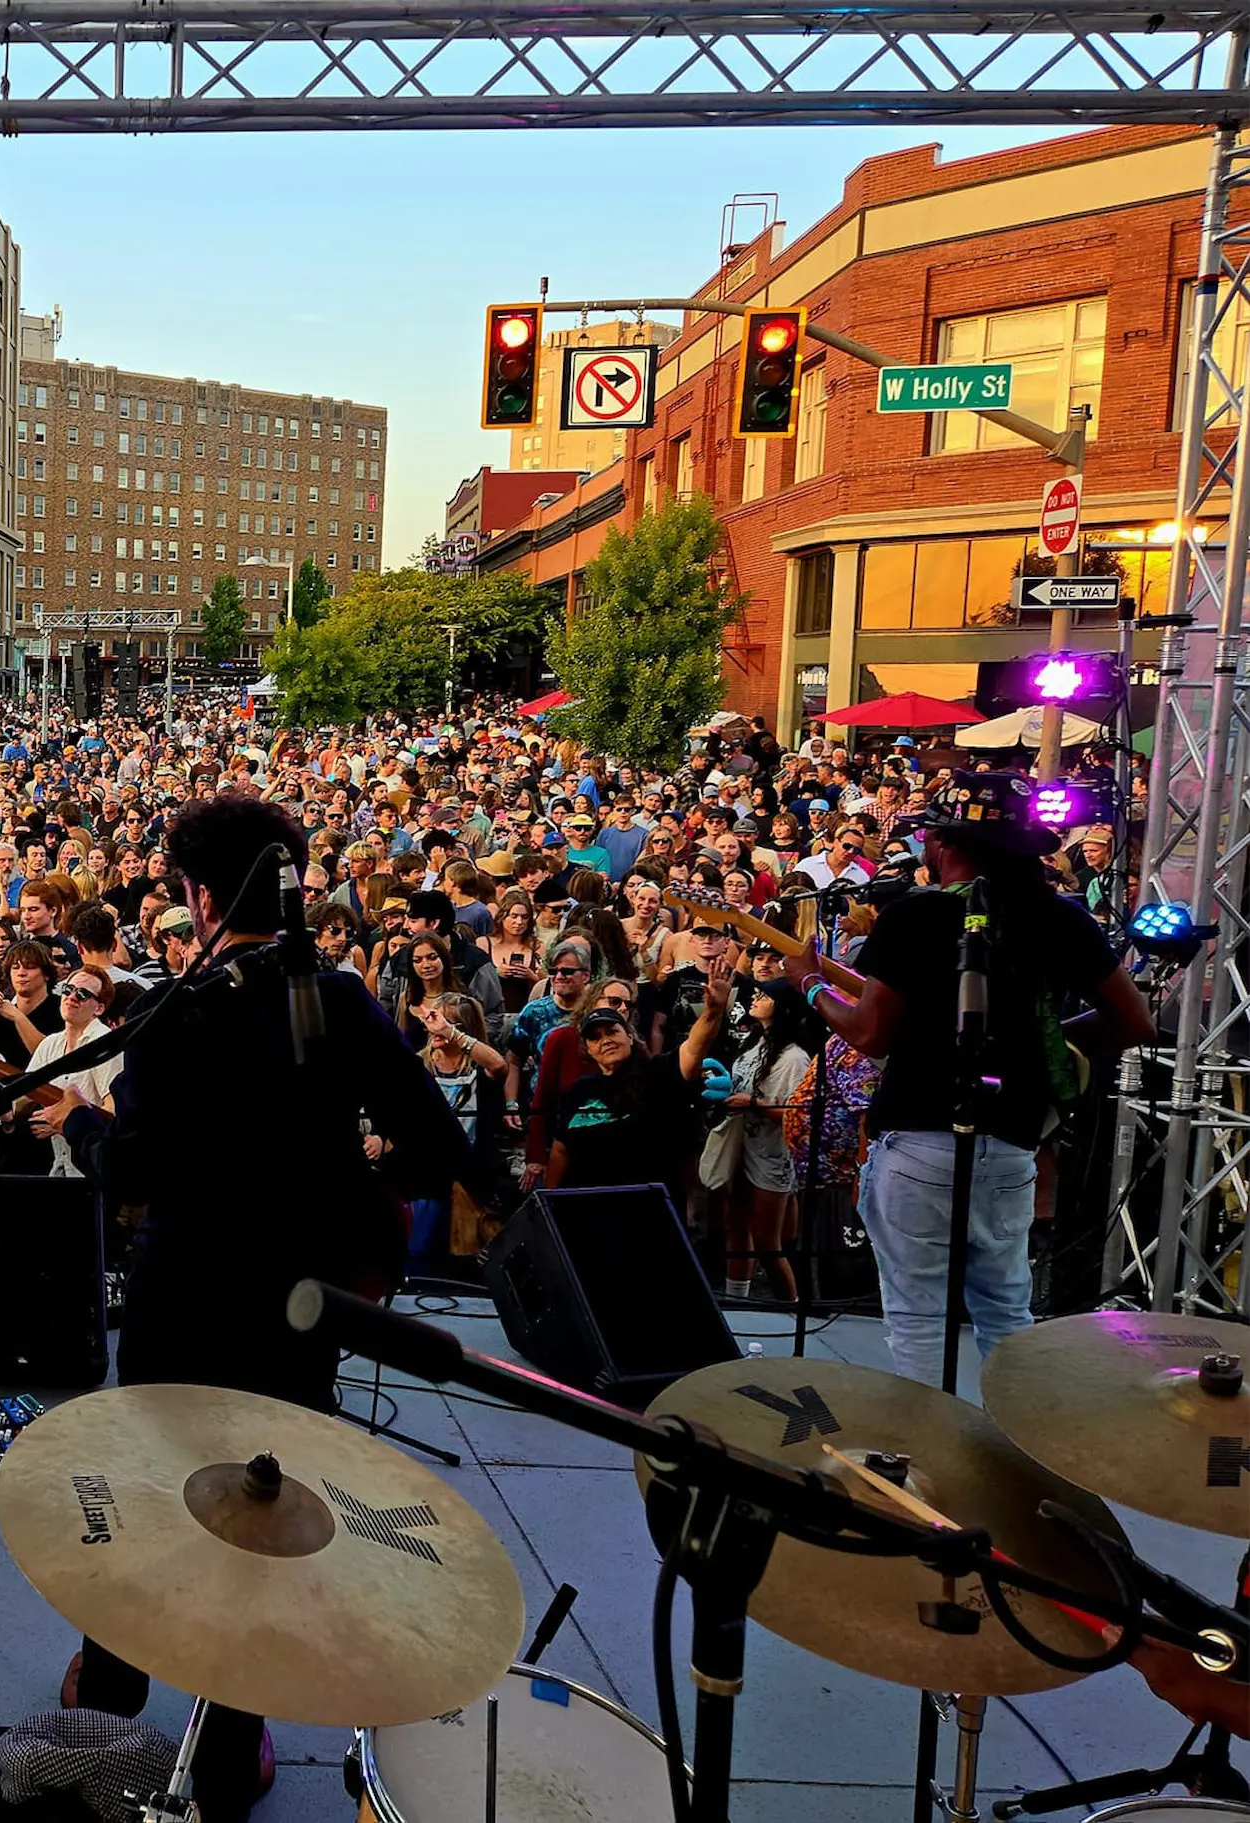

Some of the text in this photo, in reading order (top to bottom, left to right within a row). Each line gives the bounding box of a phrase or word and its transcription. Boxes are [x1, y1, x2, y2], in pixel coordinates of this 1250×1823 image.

[885, 374, 1007, 404] W Holly St
[1047, 491, 1076, 509] DO NOT
[1047, 525, 1071, 541] ENTER
[1050, 586, 1109, 599] ONE WAY
